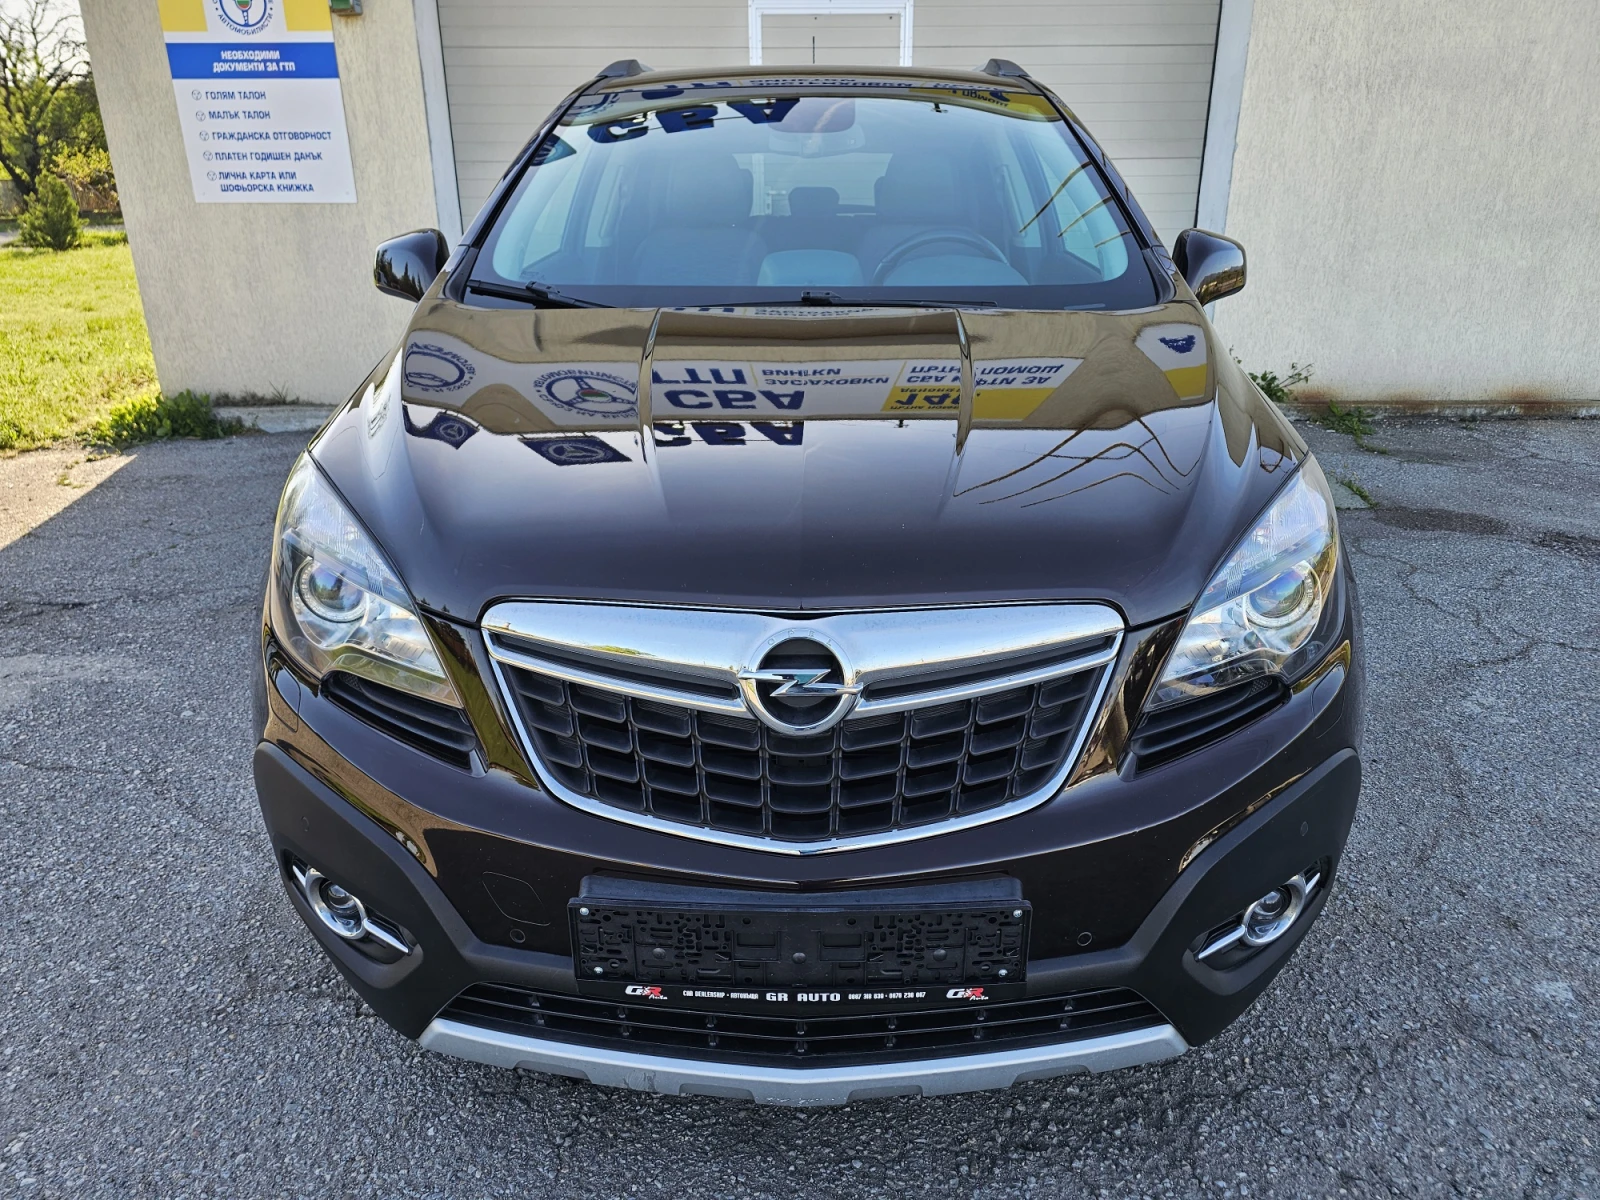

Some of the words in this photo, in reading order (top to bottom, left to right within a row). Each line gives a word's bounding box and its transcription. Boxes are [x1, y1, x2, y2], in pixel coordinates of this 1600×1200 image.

[217, 13, 274, 36] АВТОМОБИЛИСТИ
[221, 50, 280, 61] НЕОБХОДИМИ
[213, 62, 265, 73] ДОКУМЕНТИ
[266, 62, 279, 72] ЗА
[279, 62, 296, 72] ГТП
[205, 91, 236, 100] ГОЛЯМ
[238, 91, 266, 100] ТАЛОН
[208, 110, 241, 120] МАЛЪК
[242, 110, 271, 120] ТАЛОН
[212, 131, 271, 142] ГРАЖДАНСКА
[273, 131, 332, 141] ОТГОВОРНОСТ
[215, 152, 248, 161] ПЛАТЕН
[250, 152, 291, 162] ГОДИШЕН
[294, 152, 323, 162] ДАНЪК
[218, 171, 248, 180] ЛИЧНА
[249, 171, 277, 180] КАРТА
[278, 171, 297, 180] ИЛИ
[220, 183, 275, 192] ШОФЬОРСКА
[277, 183, 315, 192] КНИЖКА
[766, 992, 788, 1002] GR
[797, 992, 841, 1002] AUTO
